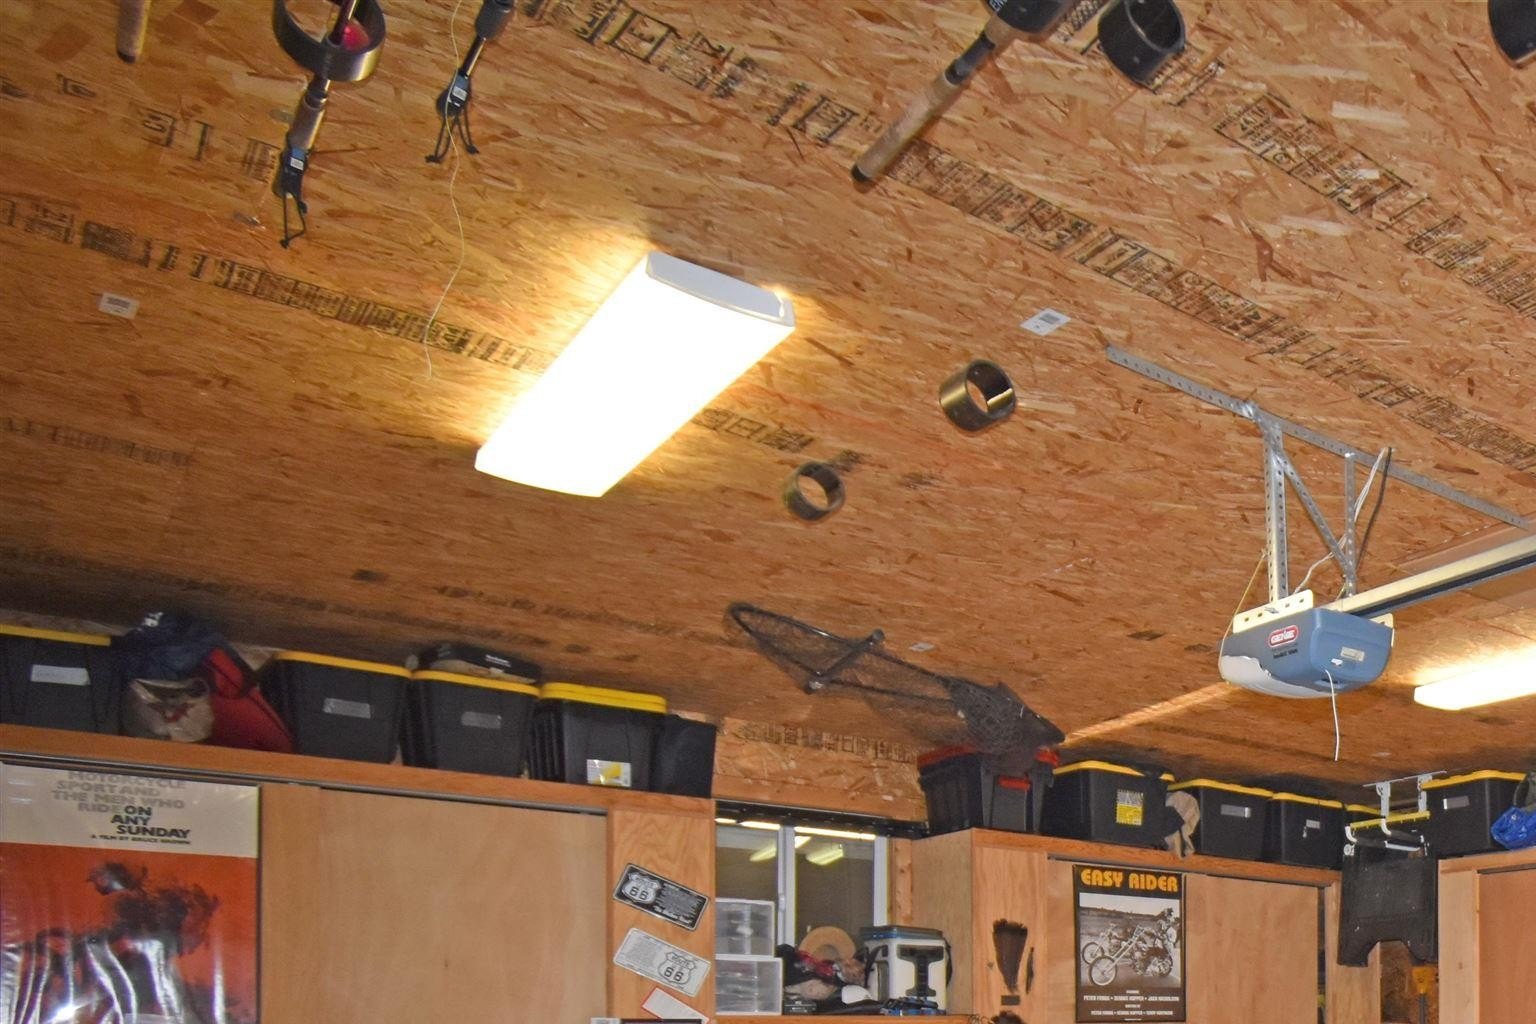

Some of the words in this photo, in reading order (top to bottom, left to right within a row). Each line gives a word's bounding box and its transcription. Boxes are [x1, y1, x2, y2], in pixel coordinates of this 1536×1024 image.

[57, 780, 118, 794] SPORT
[120, 785, 160, 797] AND
[52, 789, 88, 802] THE
[141, 797, 185, 810] WHO
[77, 801, 121, 816] RIDE
[124, 804, 152, 817] ON
[111, 813, 151, 826] ANY
[116, 824, 190, 839] SUNDAY
[1080, 868, 1124, 888] EASY
[1128, 872, 1178, 893] RIDER
[629, 886, 649, 900] 66
[664, 966, 684, 982] 66
